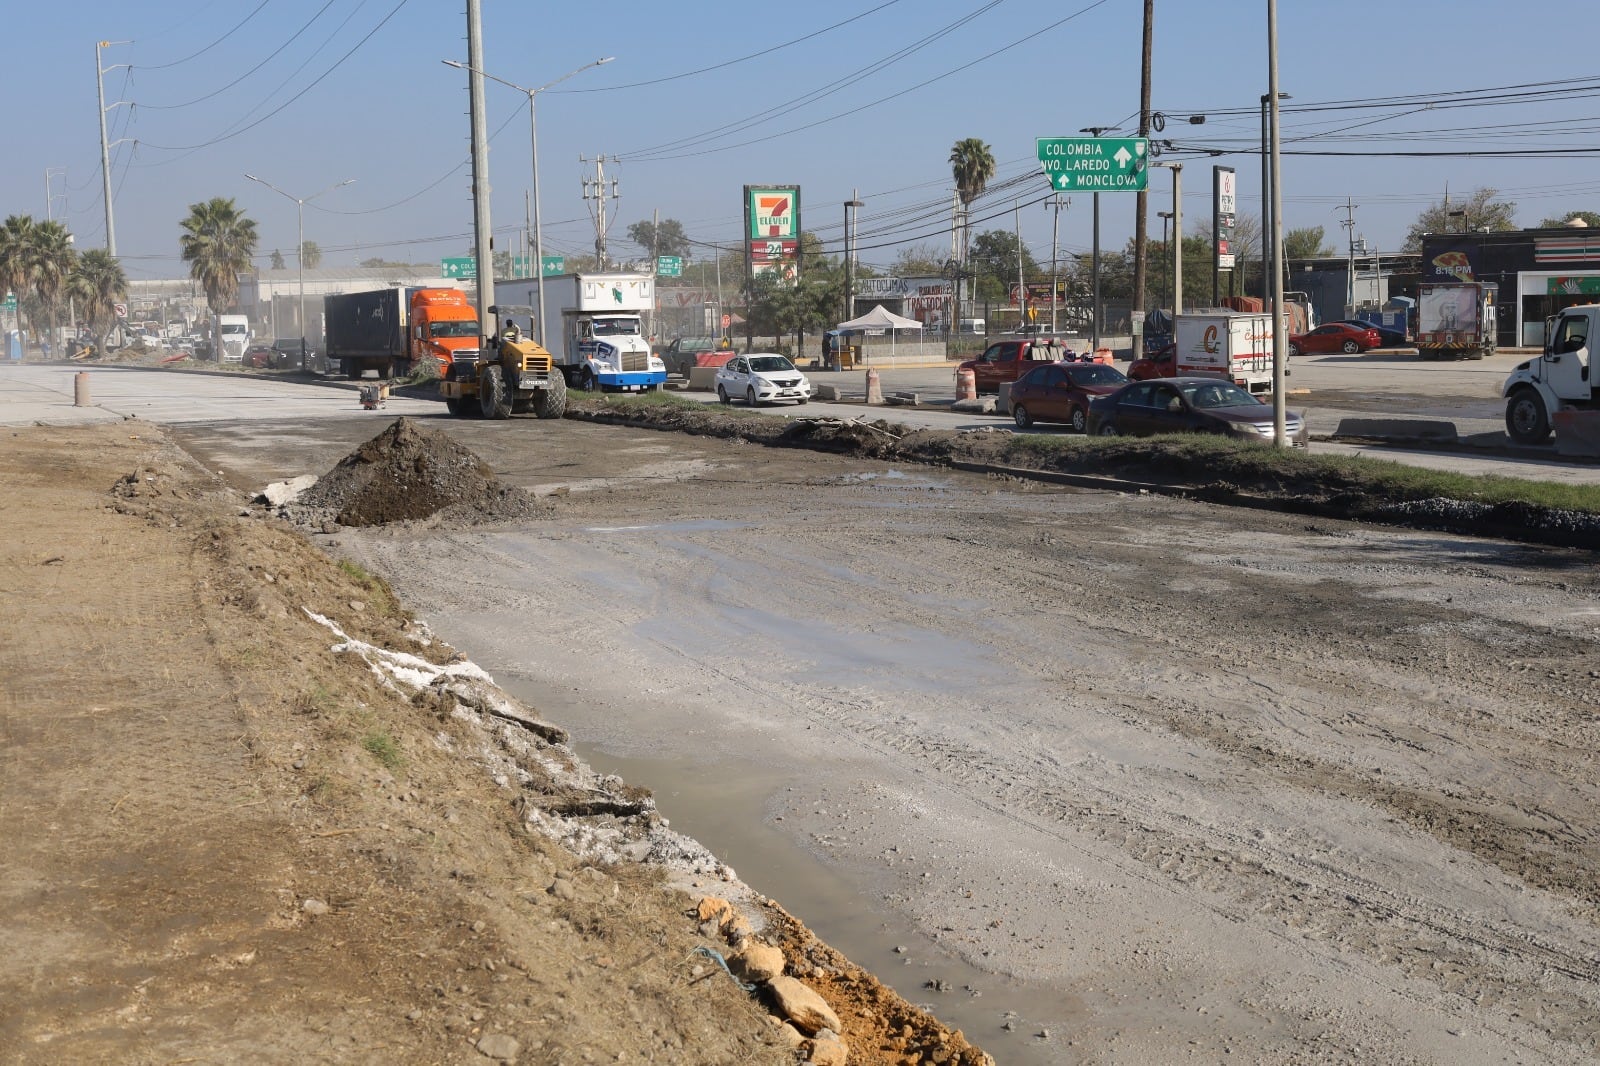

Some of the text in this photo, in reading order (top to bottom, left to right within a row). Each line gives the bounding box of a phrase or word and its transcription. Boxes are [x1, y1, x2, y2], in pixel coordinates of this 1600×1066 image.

[1046, 143, 1103, 156] COLOMBIA
[1040, 159, 1110, 171] NVO. LAREDO
[1076, 174, 1138, 186] MONCLOVA
[760, 197, 788, 237] 7
[767, 244, 782, 254] 24
[1435, 265, 1472, 275] 8:15 PM
[861, 279, 909, 294] AUTOCLIMAS
[905, 296, 953, 312] TRACTOCLIM
